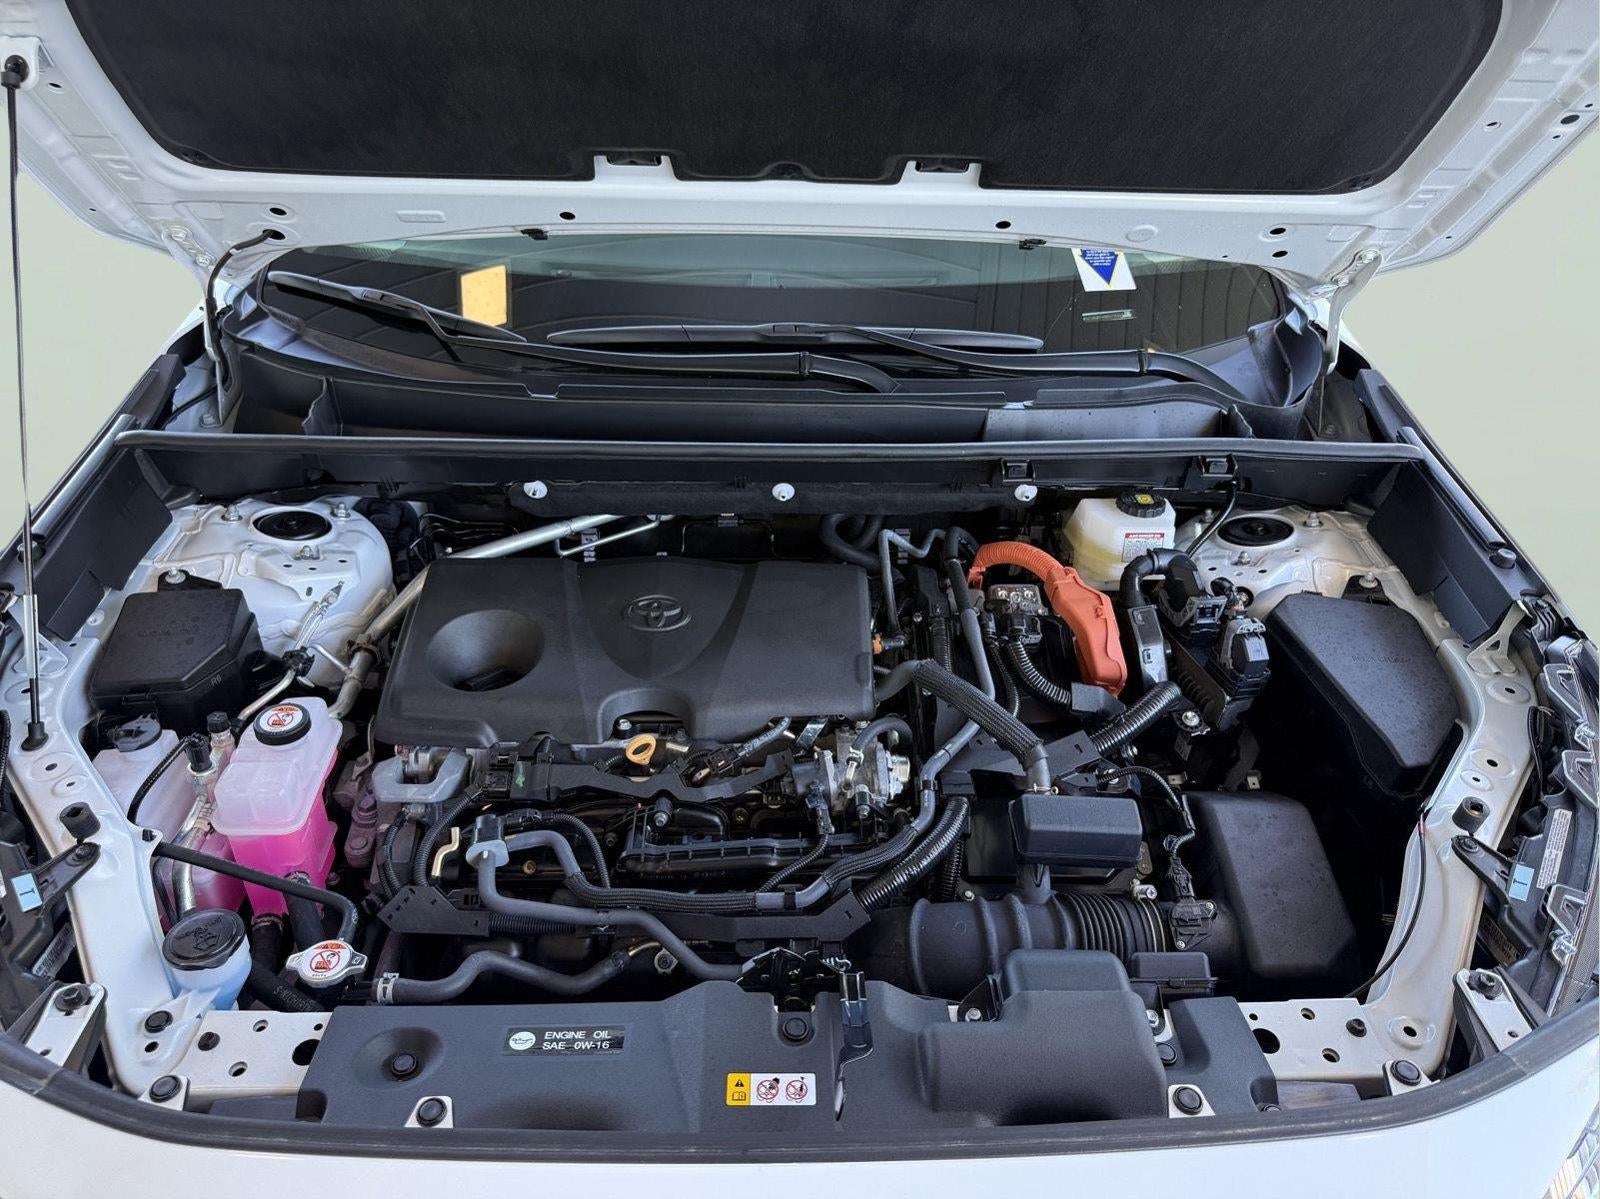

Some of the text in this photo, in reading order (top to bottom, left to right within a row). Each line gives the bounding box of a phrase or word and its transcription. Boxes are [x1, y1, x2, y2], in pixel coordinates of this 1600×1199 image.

[544, 1030, 612, 1040] ENGINE OIL
[542, 1041, 610, 1050] SAE 0W-16
